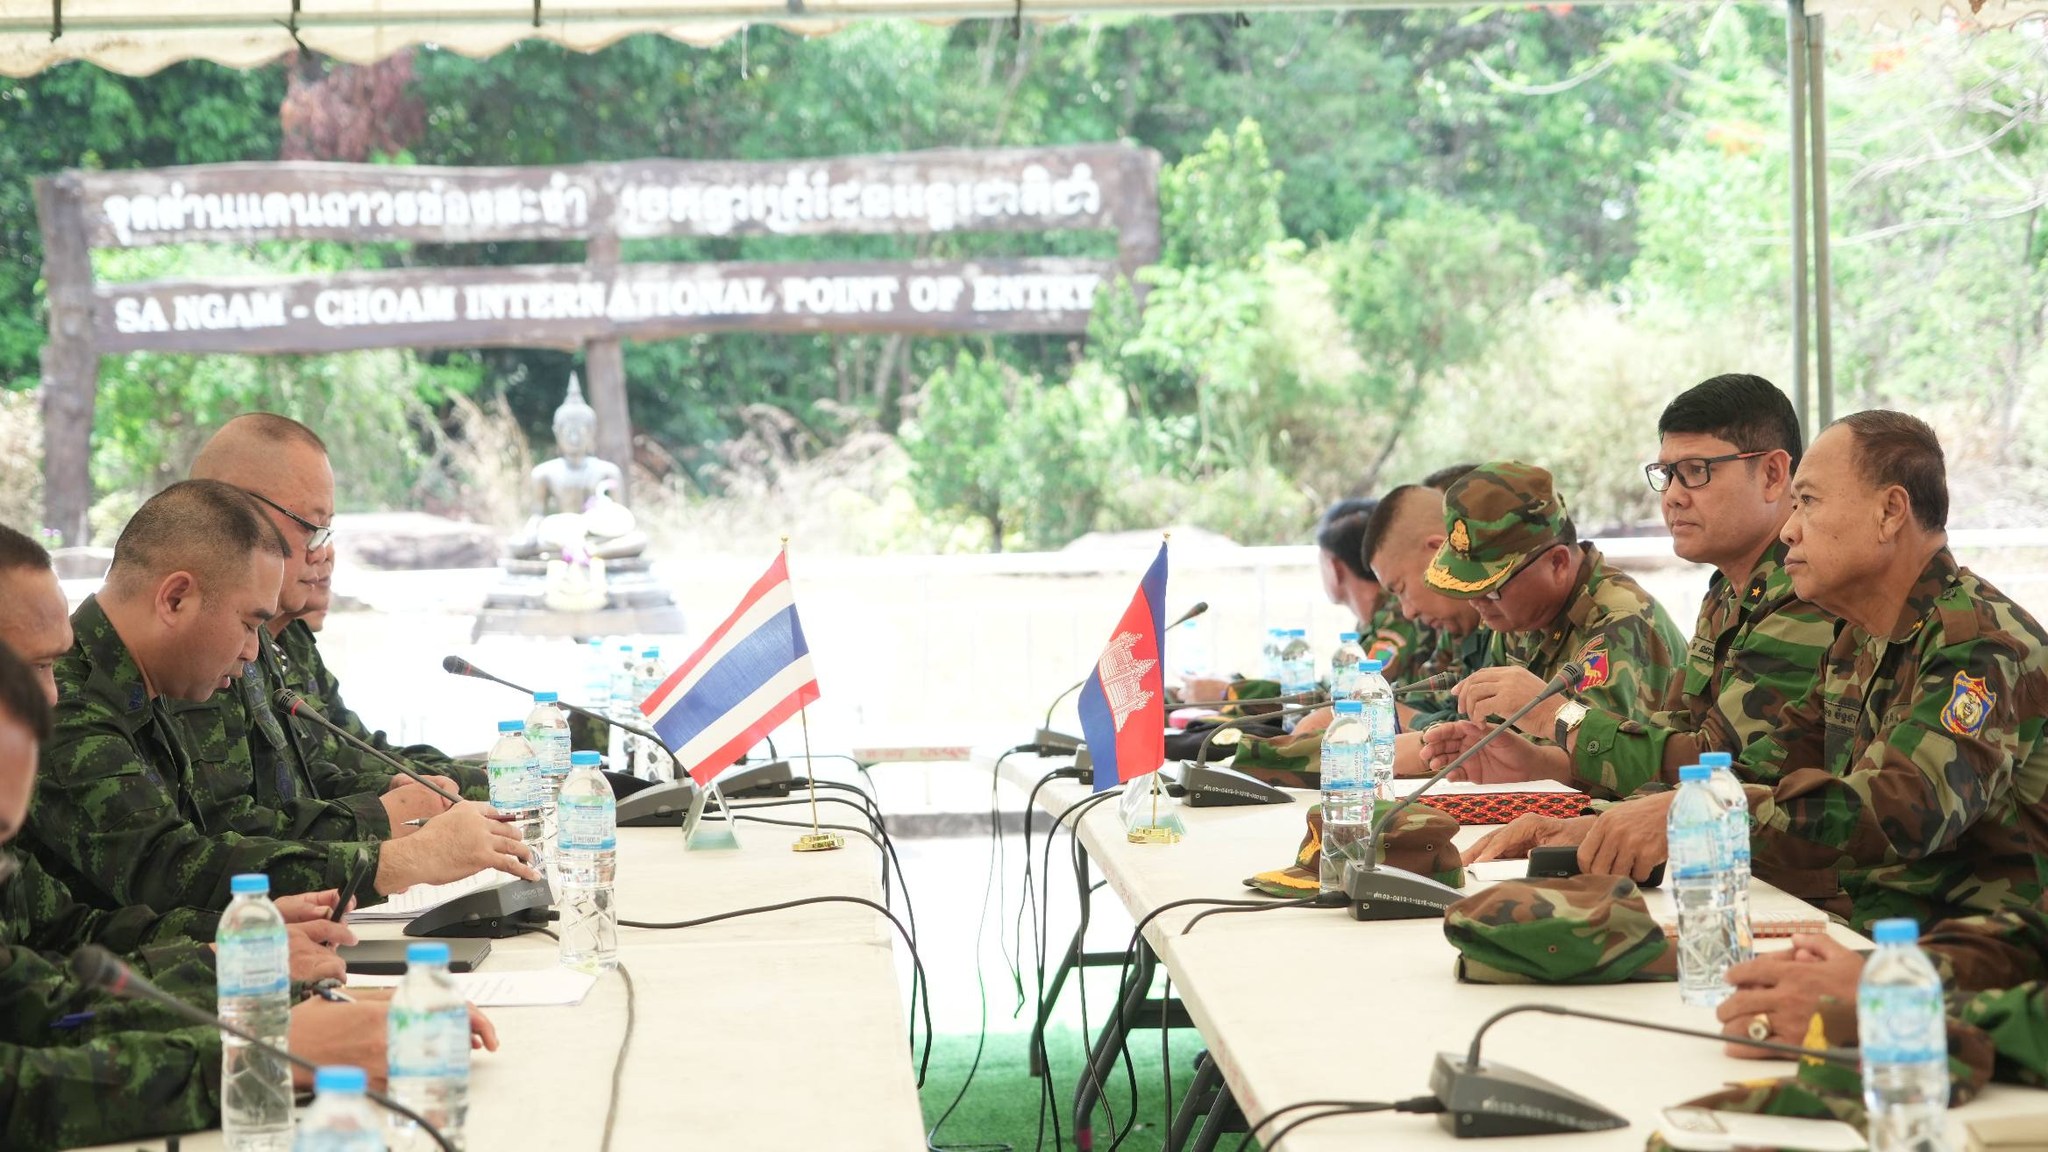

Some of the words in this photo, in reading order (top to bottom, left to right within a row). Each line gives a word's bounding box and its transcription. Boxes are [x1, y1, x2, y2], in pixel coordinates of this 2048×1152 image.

[115, 297, 169, 333] SA
[173, 291, 286, 331] NGAM
[314, 286, 456, 327] CHOAM
[464, 276, 774, 320] INTERNATIONAL
[781, 276, 900, 315] POINT
[908, 276, 964, 313] OF
[971, 272, 1100, 312] ENTRY
